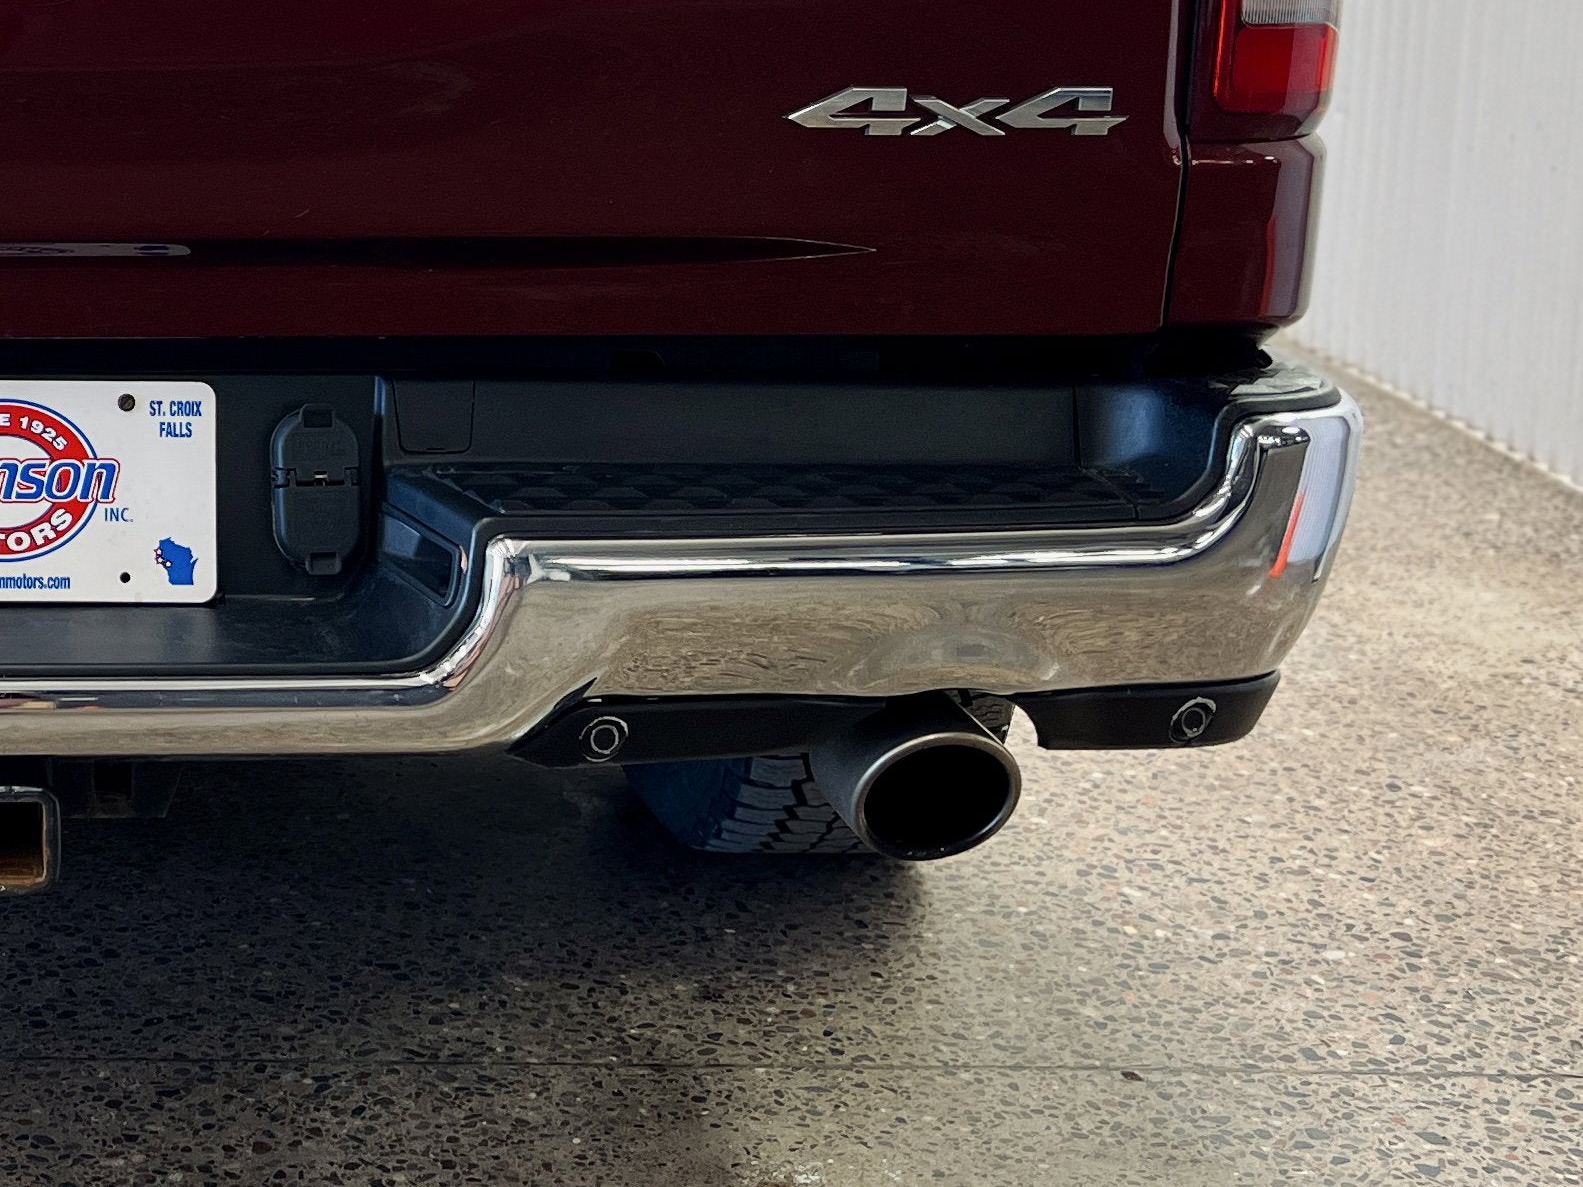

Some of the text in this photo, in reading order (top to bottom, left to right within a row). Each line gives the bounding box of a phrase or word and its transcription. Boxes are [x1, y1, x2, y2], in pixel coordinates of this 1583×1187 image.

[149, 400, 202, 417] ST. CROIX
[19, 415, 68, 450] 1925
[159, 421, 193, 438] FALLS
[104, 507, 134, 523] INC.
